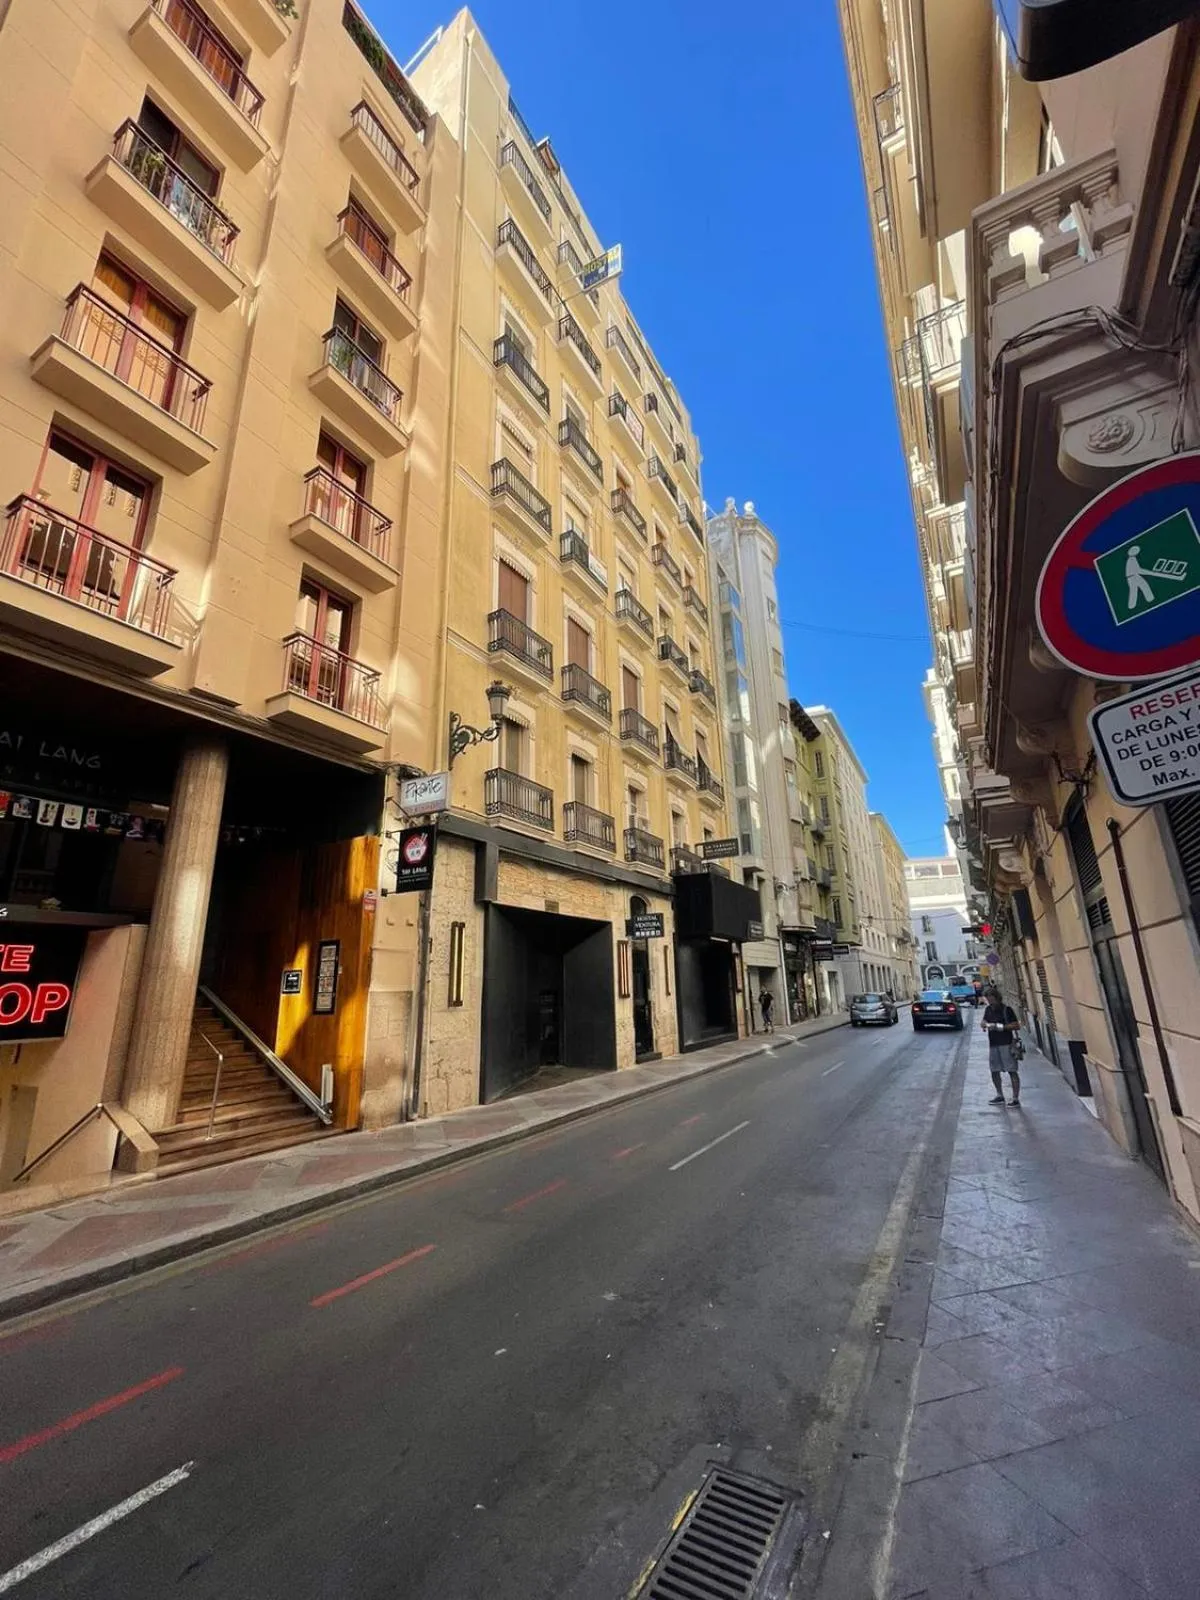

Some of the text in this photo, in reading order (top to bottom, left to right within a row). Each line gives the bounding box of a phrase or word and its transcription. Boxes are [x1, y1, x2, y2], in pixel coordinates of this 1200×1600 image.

[1111, 708, 1191, 744] CARGA Y
[39, 740, 102, 769] LANG
[1117, 744, 1142, 761] DE
[1139, 742, 1200, 772] DE 9:0
[1152, 768, 1196, 786] Max.
